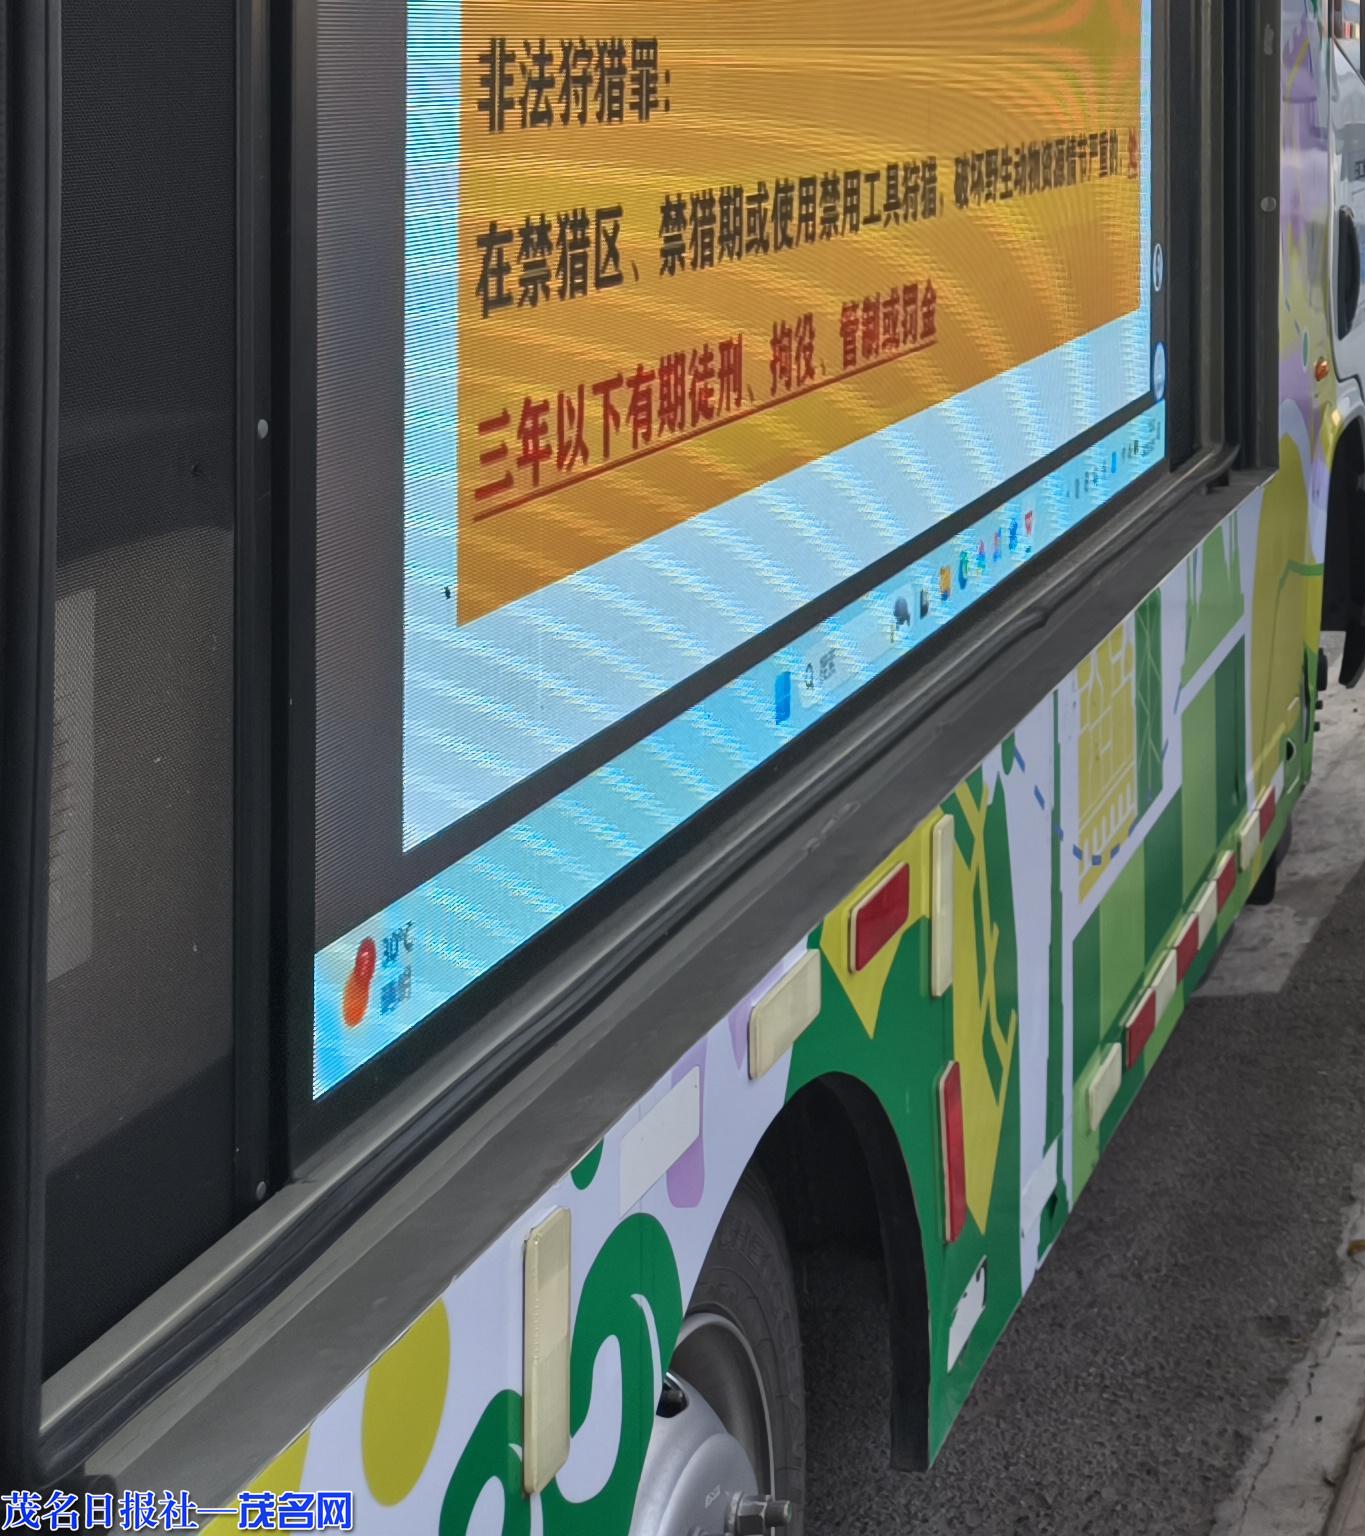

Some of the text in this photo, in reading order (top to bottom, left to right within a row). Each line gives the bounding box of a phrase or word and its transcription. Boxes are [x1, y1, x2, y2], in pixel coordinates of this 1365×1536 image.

[477, 36, 671, 134] 非法狩猎罪：
